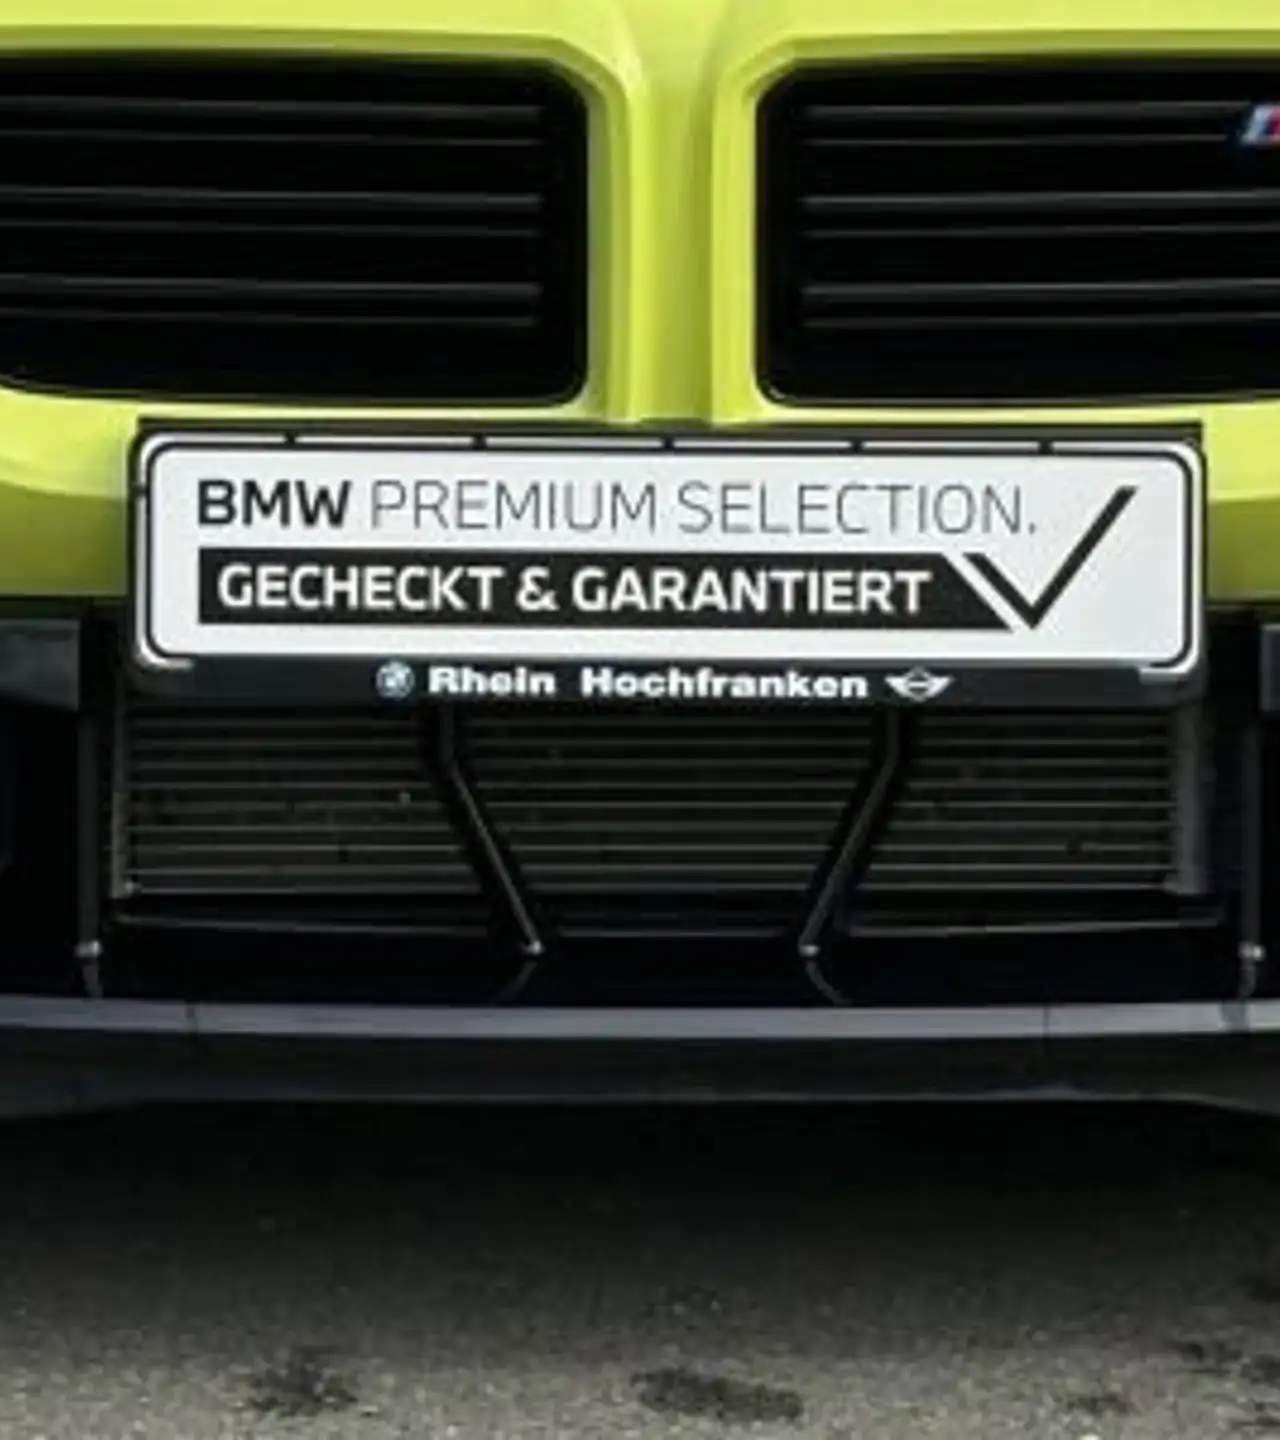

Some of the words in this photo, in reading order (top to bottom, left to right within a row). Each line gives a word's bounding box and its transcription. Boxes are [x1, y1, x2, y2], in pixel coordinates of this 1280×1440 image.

[196, 478, 353, 529] BMW
[371, 479, 657, 534] PREMIUM
[677, 481, 1038, 537] SELECTION.
[217, 562, 505, 613] GECHECKT
[515, 564, 560, 613] &
[572, 565, 933, 615] GARANTIERT
[428, 665, 557, 698] Rhein
[580, 666, 869, 700] Hochfranken
